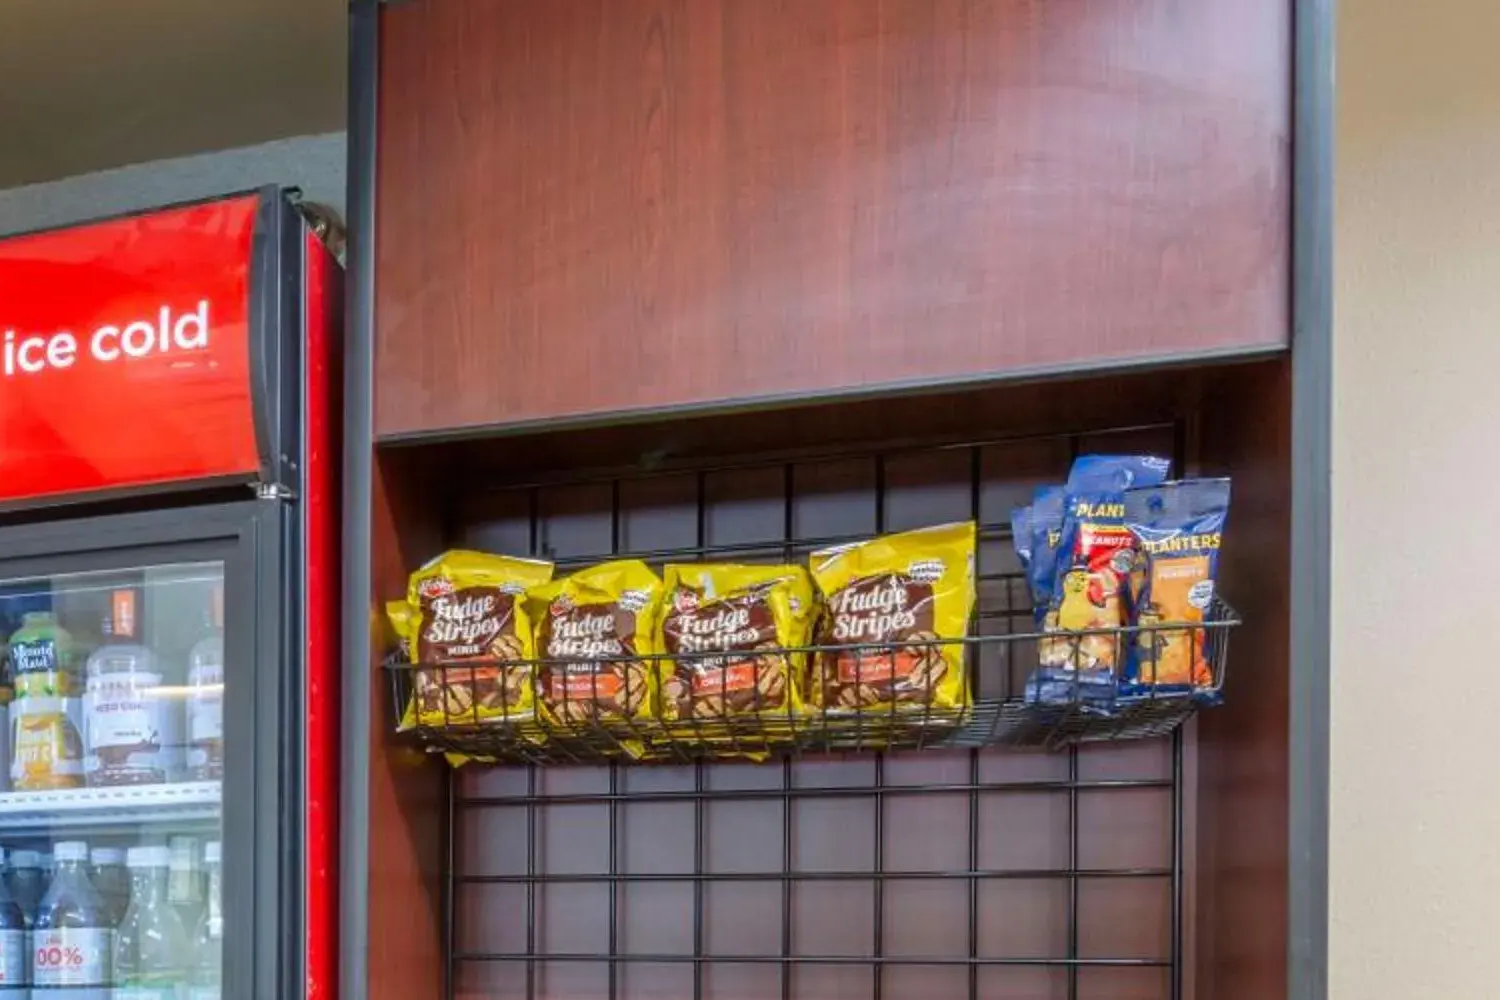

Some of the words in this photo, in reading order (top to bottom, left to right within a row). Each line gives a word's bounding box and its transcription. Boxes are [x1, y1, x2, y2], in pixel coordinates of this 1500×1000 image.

[4, 330, 78, 376] ice
[91, 299, 209, 361] cold
[430, 595, 496, 620] Fudge
[839, 582, 909, 612] Fudge
[428, 615, 501, 644] Stripes
[551, 613, 615, 639] Fudge
[678, 609, 750, 635] Fudge
[832, 607, 917, 641] Stripes
